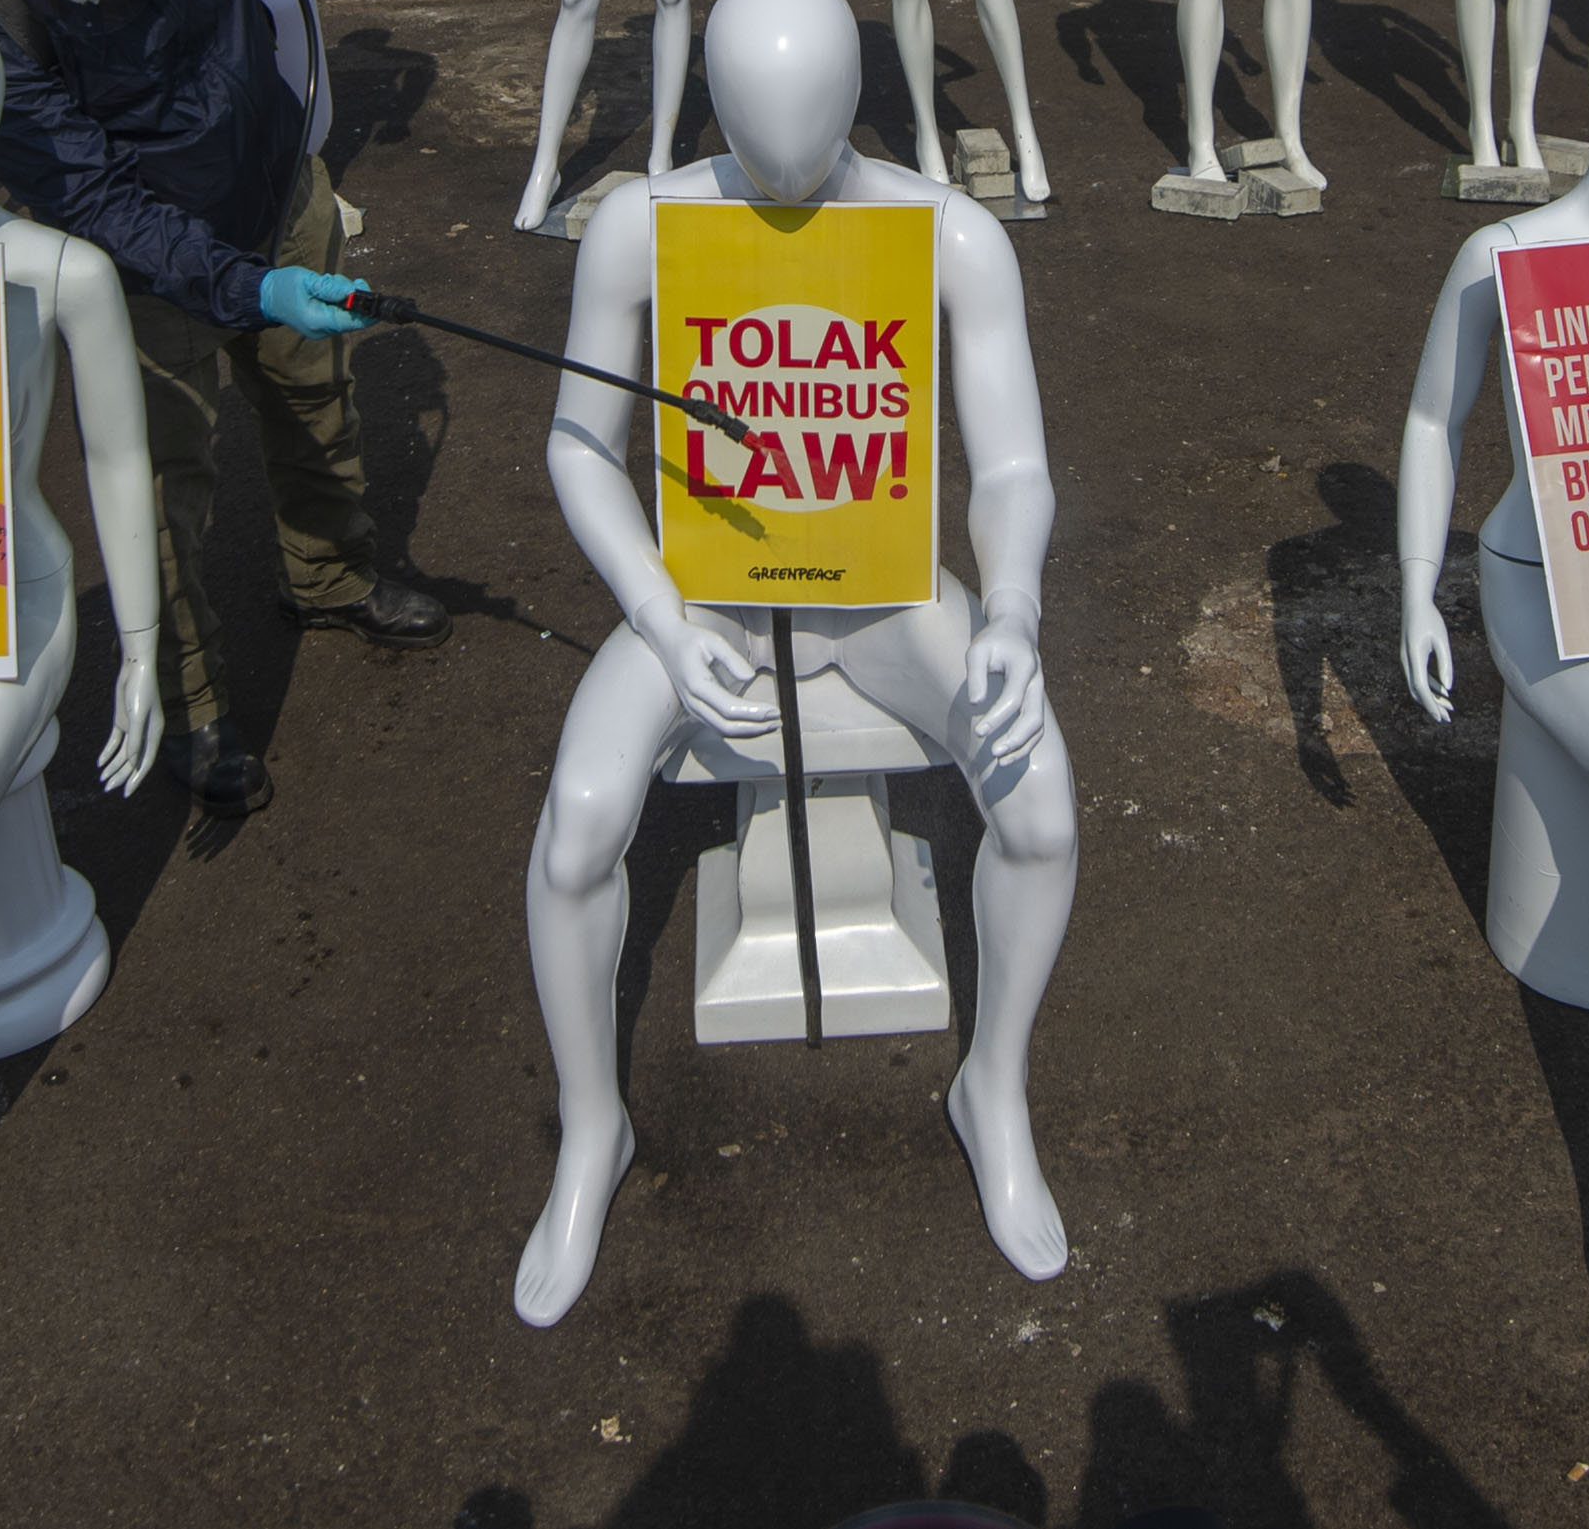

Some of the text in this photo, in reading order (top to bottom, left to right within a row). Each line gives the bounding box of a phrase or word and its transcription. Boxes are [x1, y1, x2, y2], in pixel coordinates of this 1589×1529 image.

[685, 317, 908, 369] TOLAK
[682, 380, 910, 419] OMNIBUS
[686, 430, 909, 500] LAW!
[747, 566, 846, 582] GREENPEACE
